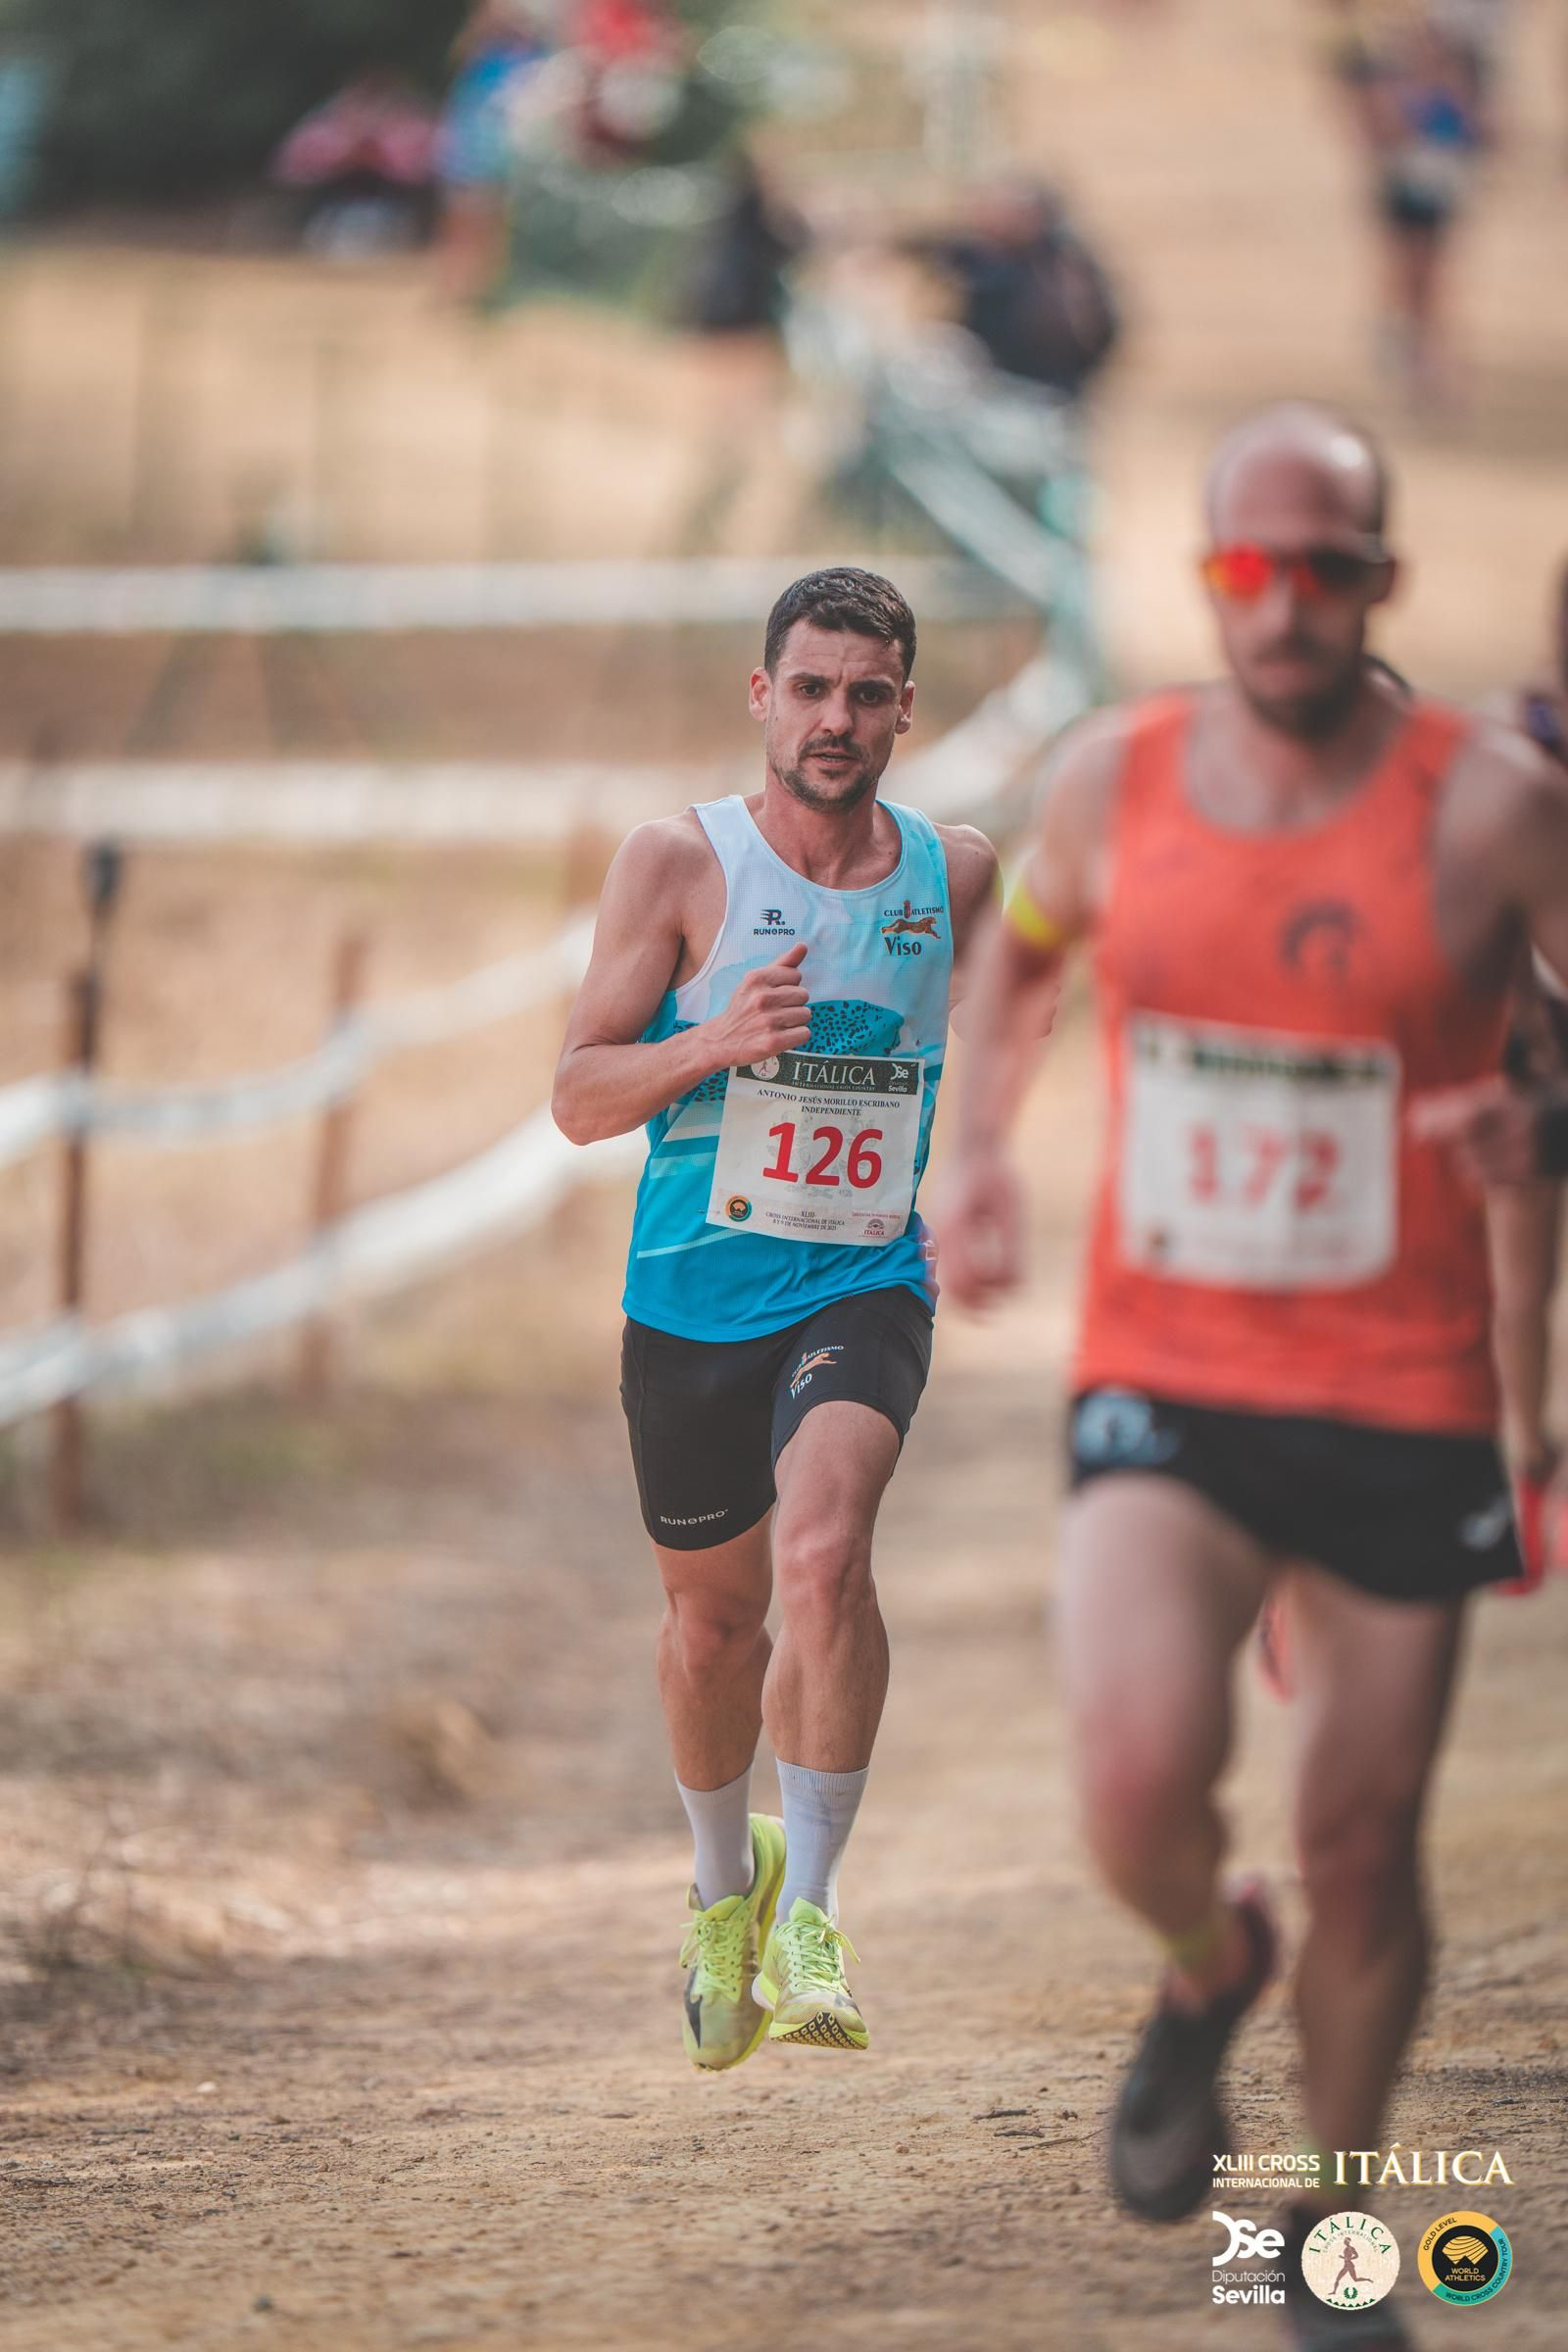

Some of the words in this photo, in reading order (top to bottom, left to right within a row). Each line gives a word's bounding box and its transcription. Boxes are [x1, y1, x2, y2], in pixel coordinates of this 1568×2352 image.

[884, 908, 904, 917] CLUB
[911, 906, 945, 917] ATLETISMO
[884, 936, 922, 956] Viso
[792, 1060, 876, 1086] ITÁLICA
[758, 1089, 797, 1102] ANTONIO
[799, 1095, 822, 1104] JESÚS
[824, 1097, 858, 1107] MORILLO
[858, 1099, 901, 1109] ESCRIBANO
[802, 1105, 861, 1116] INDEPENDIENTE
[762, 1122, 884, 1189] 126
[1186, 1122, 1343, 1217] 172
